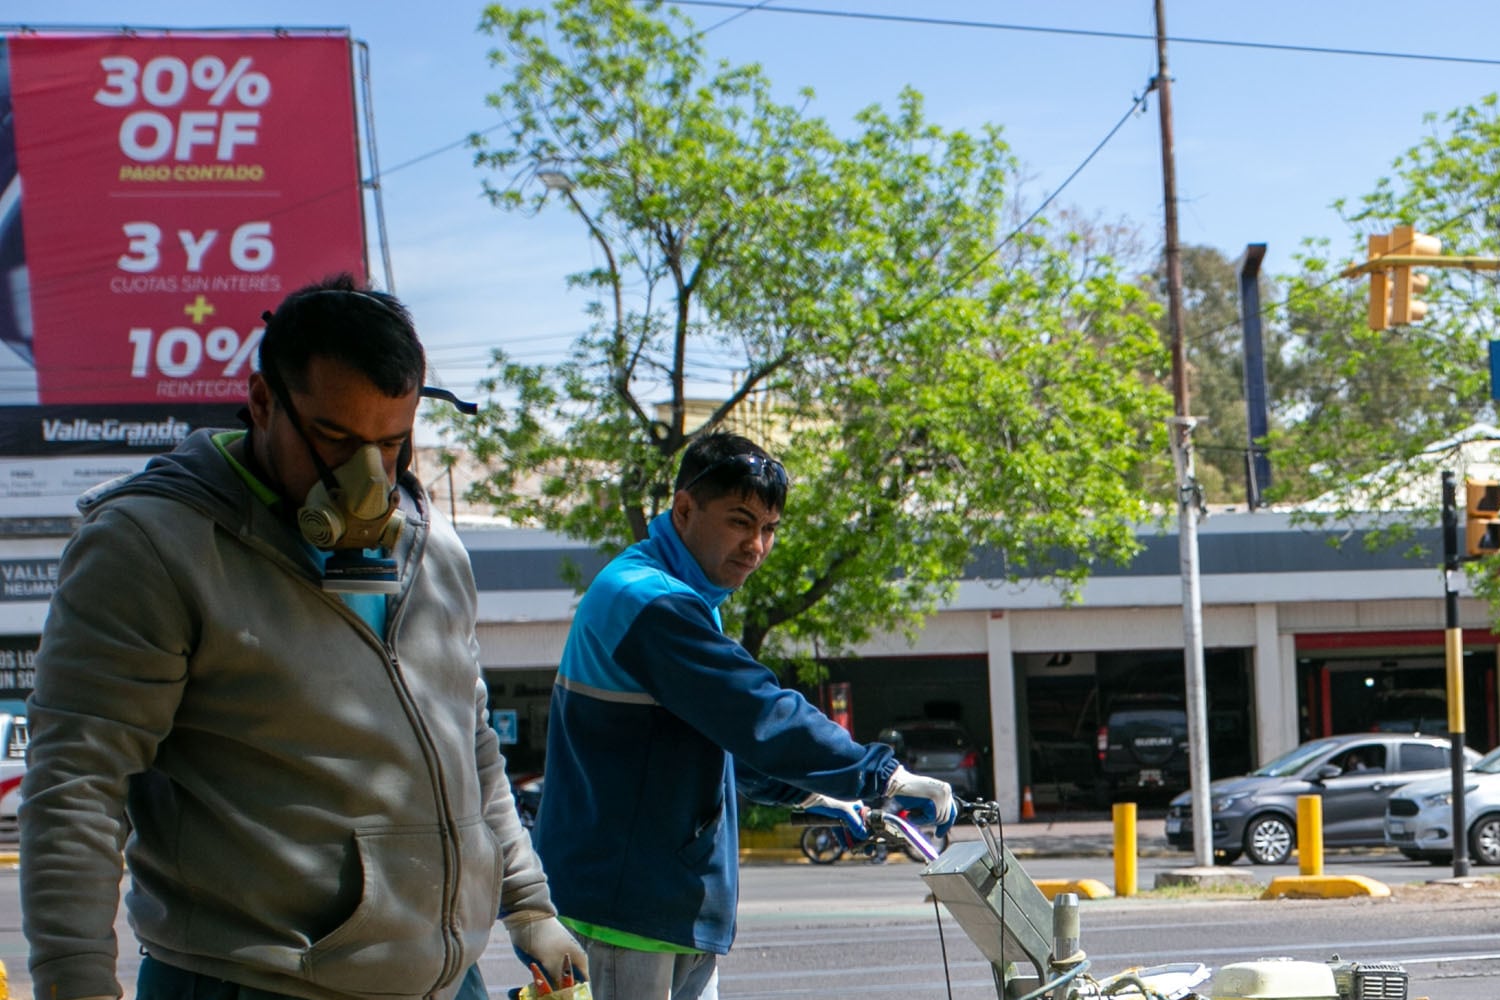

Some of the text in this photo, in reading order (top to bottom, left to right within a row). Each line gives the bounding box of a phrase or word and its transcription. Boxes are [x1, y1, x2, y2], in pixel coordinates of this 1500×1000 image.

[93, 55, 271, 107] 30%
[118, 110, 261, 162] OFF
[119, 165, 265, 182] PAGO CONTADO
[117, 221, 274, 273] 3 Y 6
[110, 274, 282, 293] CUOTAS SIN INTERÉS
[128, 326, 266, 378] 10%
